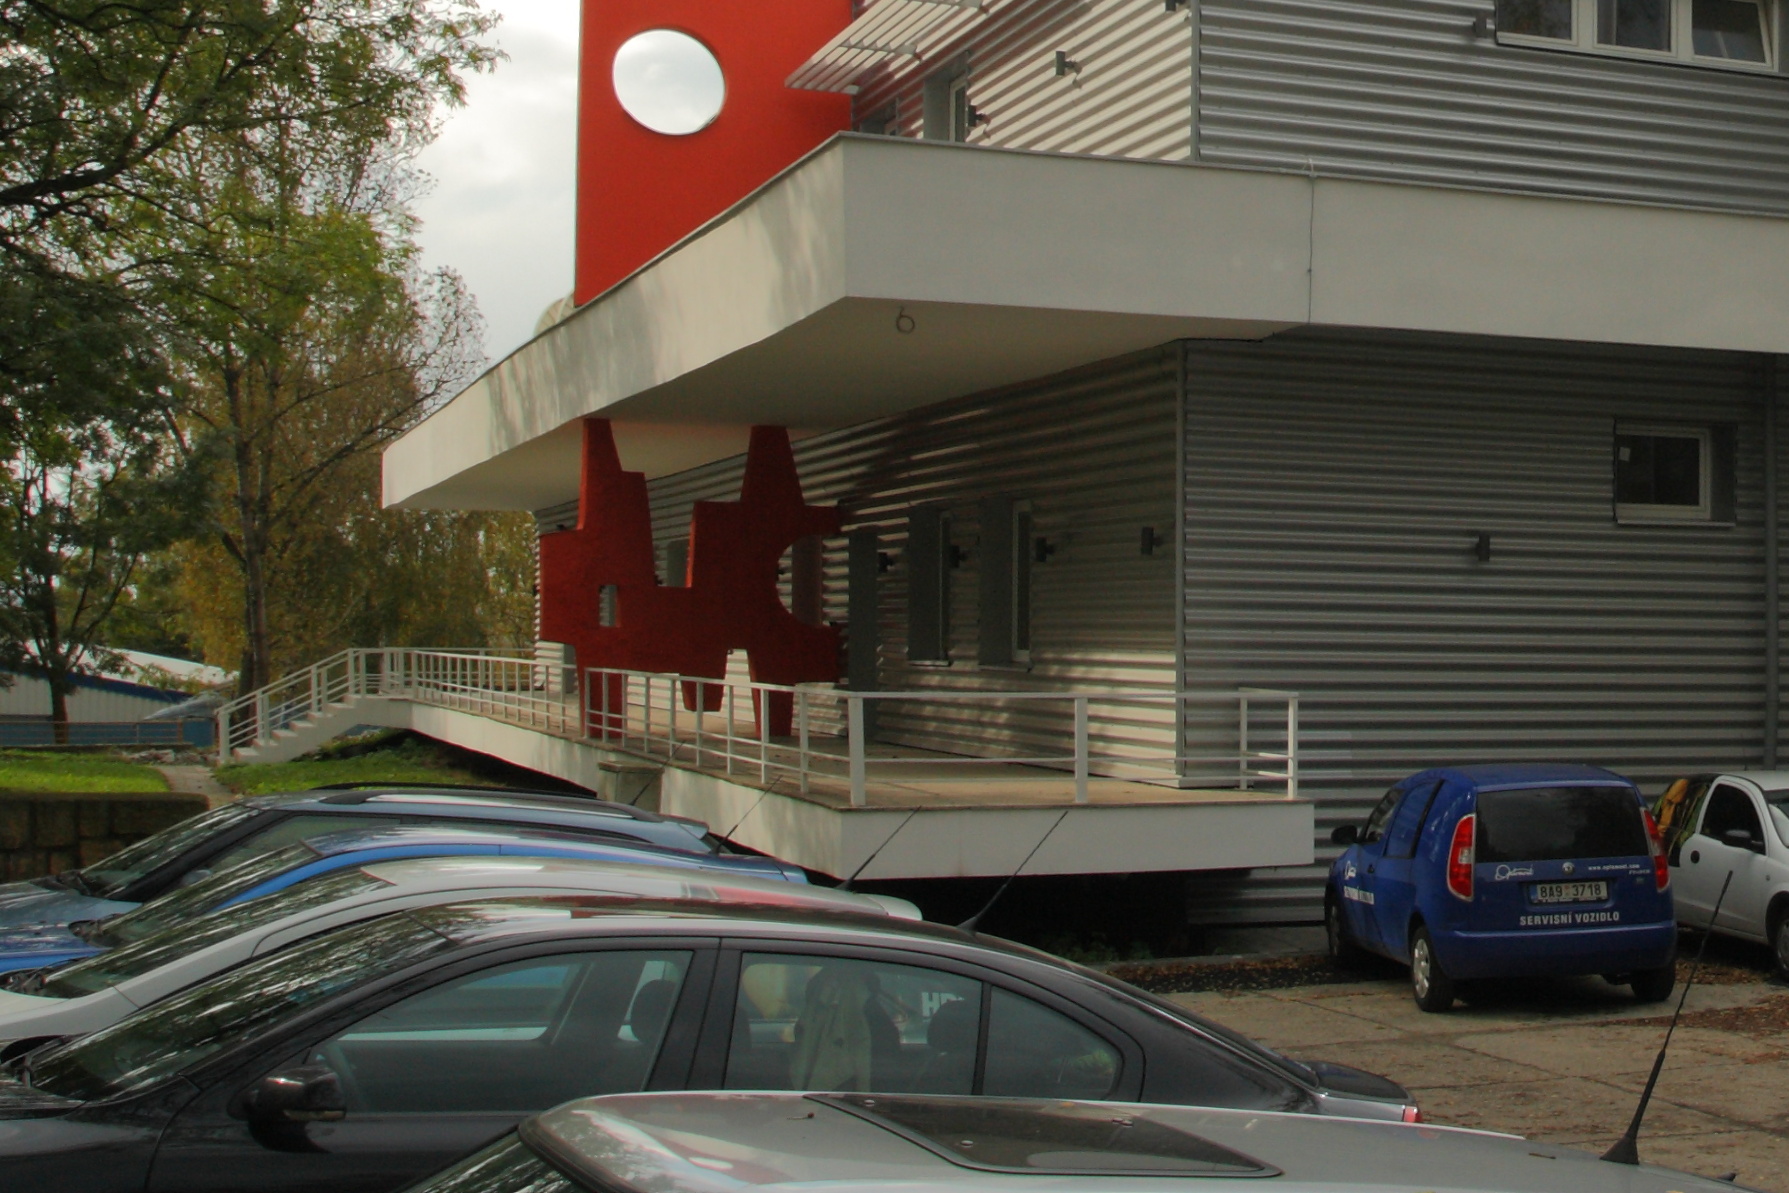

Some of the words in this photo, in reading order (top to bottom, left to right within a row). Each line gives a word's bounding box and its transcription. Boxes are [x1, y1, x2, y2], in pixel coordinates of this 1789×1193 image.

[1540, 885, 1563, 898] 8A9
[1572, 883, 1602, 897] 3718
[1520, 911, 1572, 925] SERVISNÍ
[1575, 911, 1620, 923] VOZIDLO
